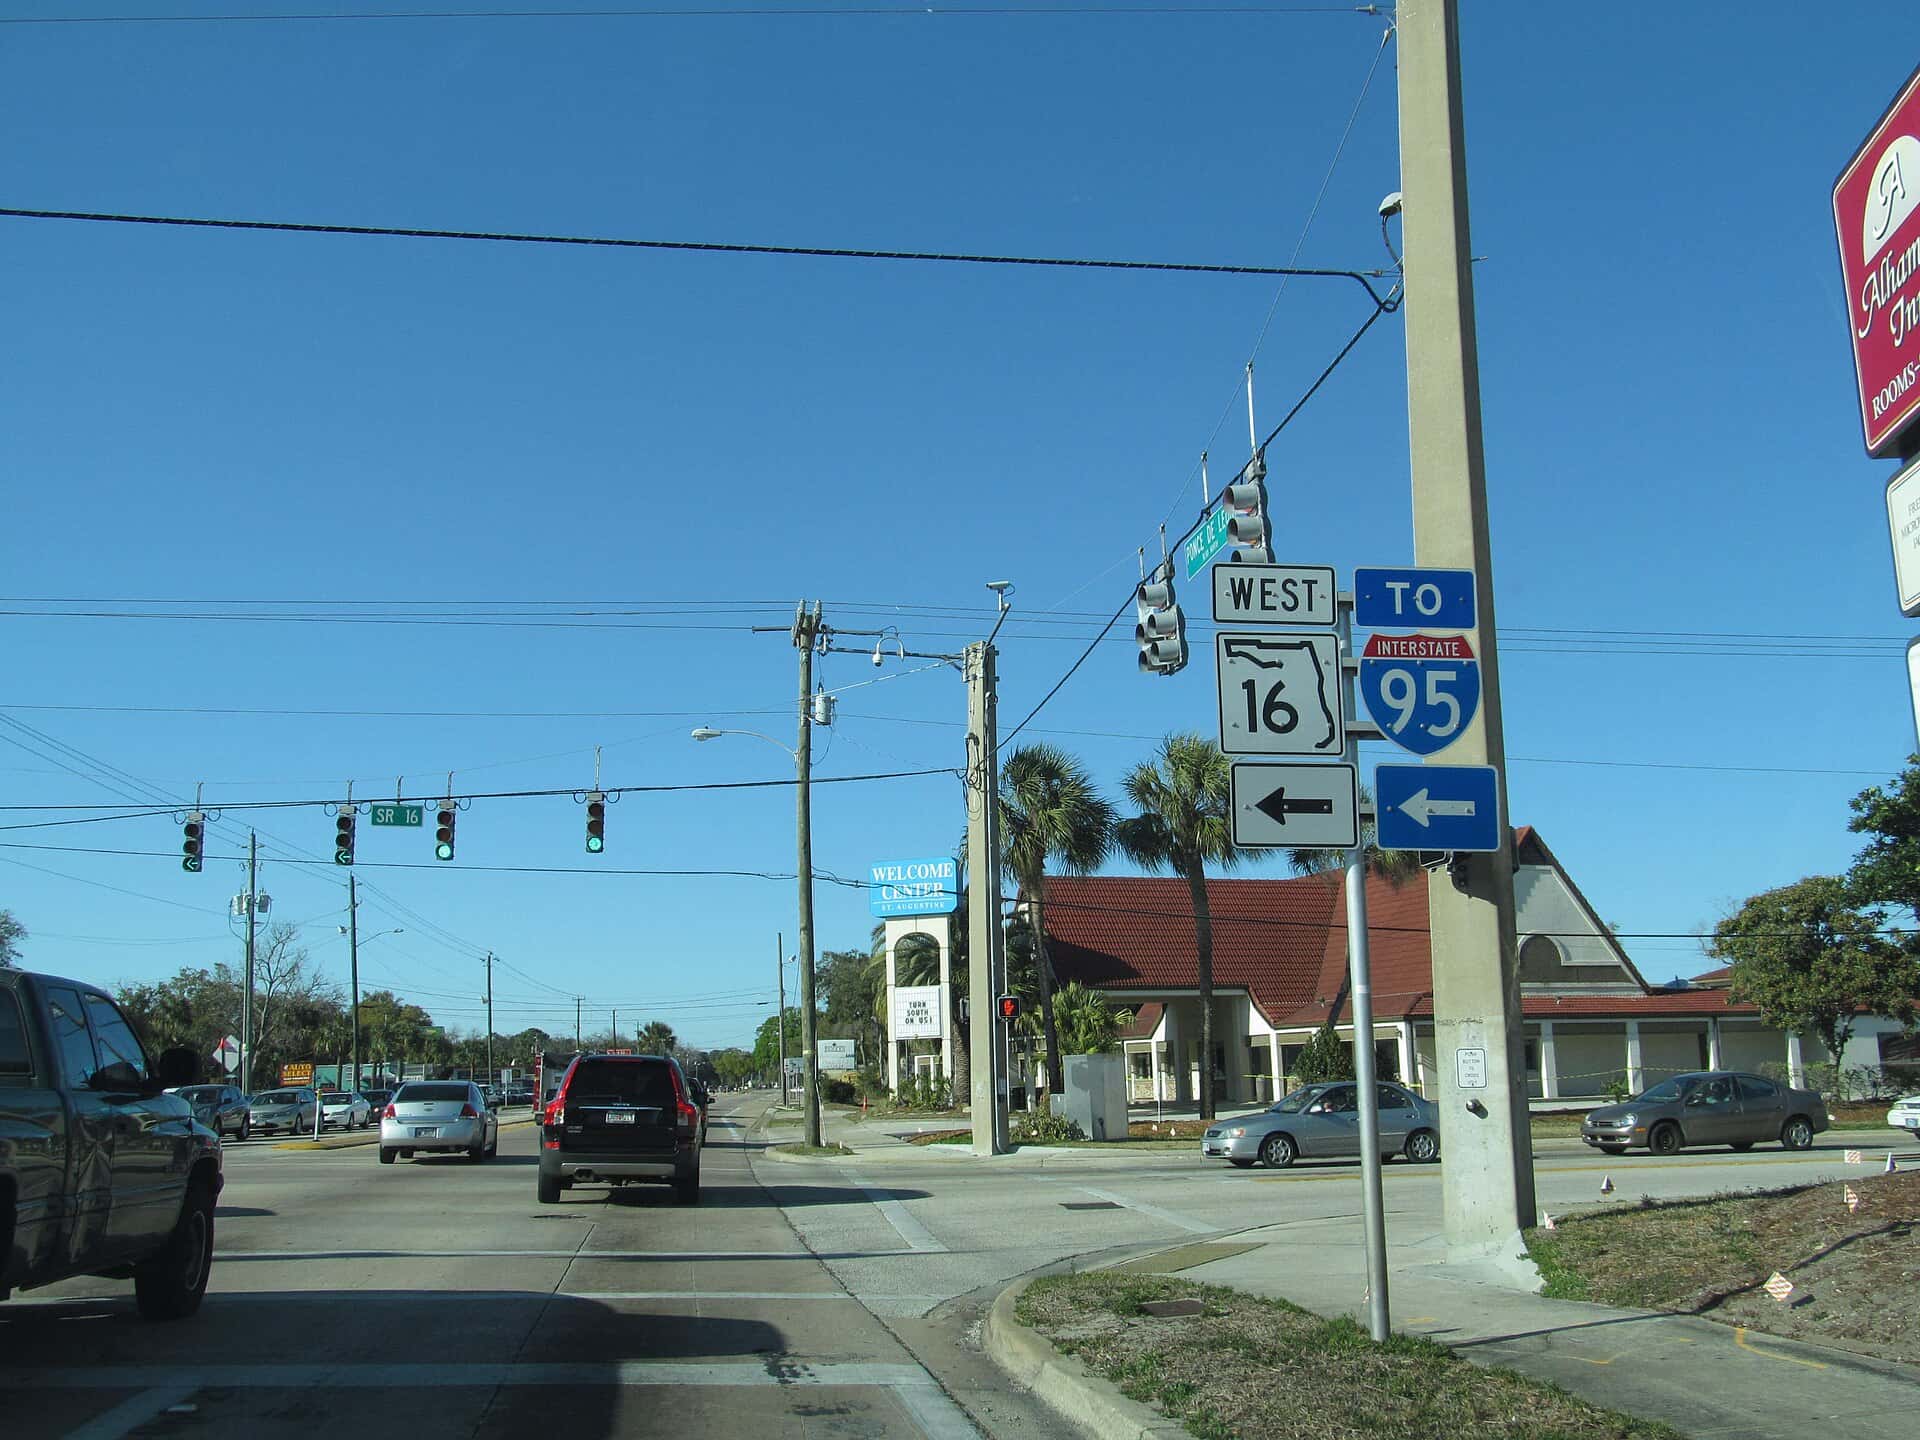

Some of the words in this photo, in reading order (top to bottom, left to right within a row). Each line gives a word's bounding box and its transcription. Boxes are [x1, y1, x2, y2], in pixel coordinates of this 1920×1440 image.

[1889, 293, 1920, 348] In
[1185, 531, 1205, 565] PONCE
[1206, 520, 1215, 544] DE
[1229, 576, 1319, 612] WEST
[1385, 581, 1443, 617] TO
[1376, 639, 1461, 658] INTERSTATE
[1241, 679, 1299, 735] 16
[1380, 668, 1461, 737] 95
[376, 809, 394, 824] SR
[405, 809, 418, 824] 16
[872, 862, 953, 881] WELCOME
[881, 882, 944, 901] CENTER
[881, 904, 894, 912] ST.
[896, 901, 945, 911] AUGUSTINE
[906, 1009, 929, 1017] SOUTH
[909, 1001, 927, 1009] TURN
[905, 1017, 915, 1025] ON
[288, 1063, 312, 1071] AUTO
